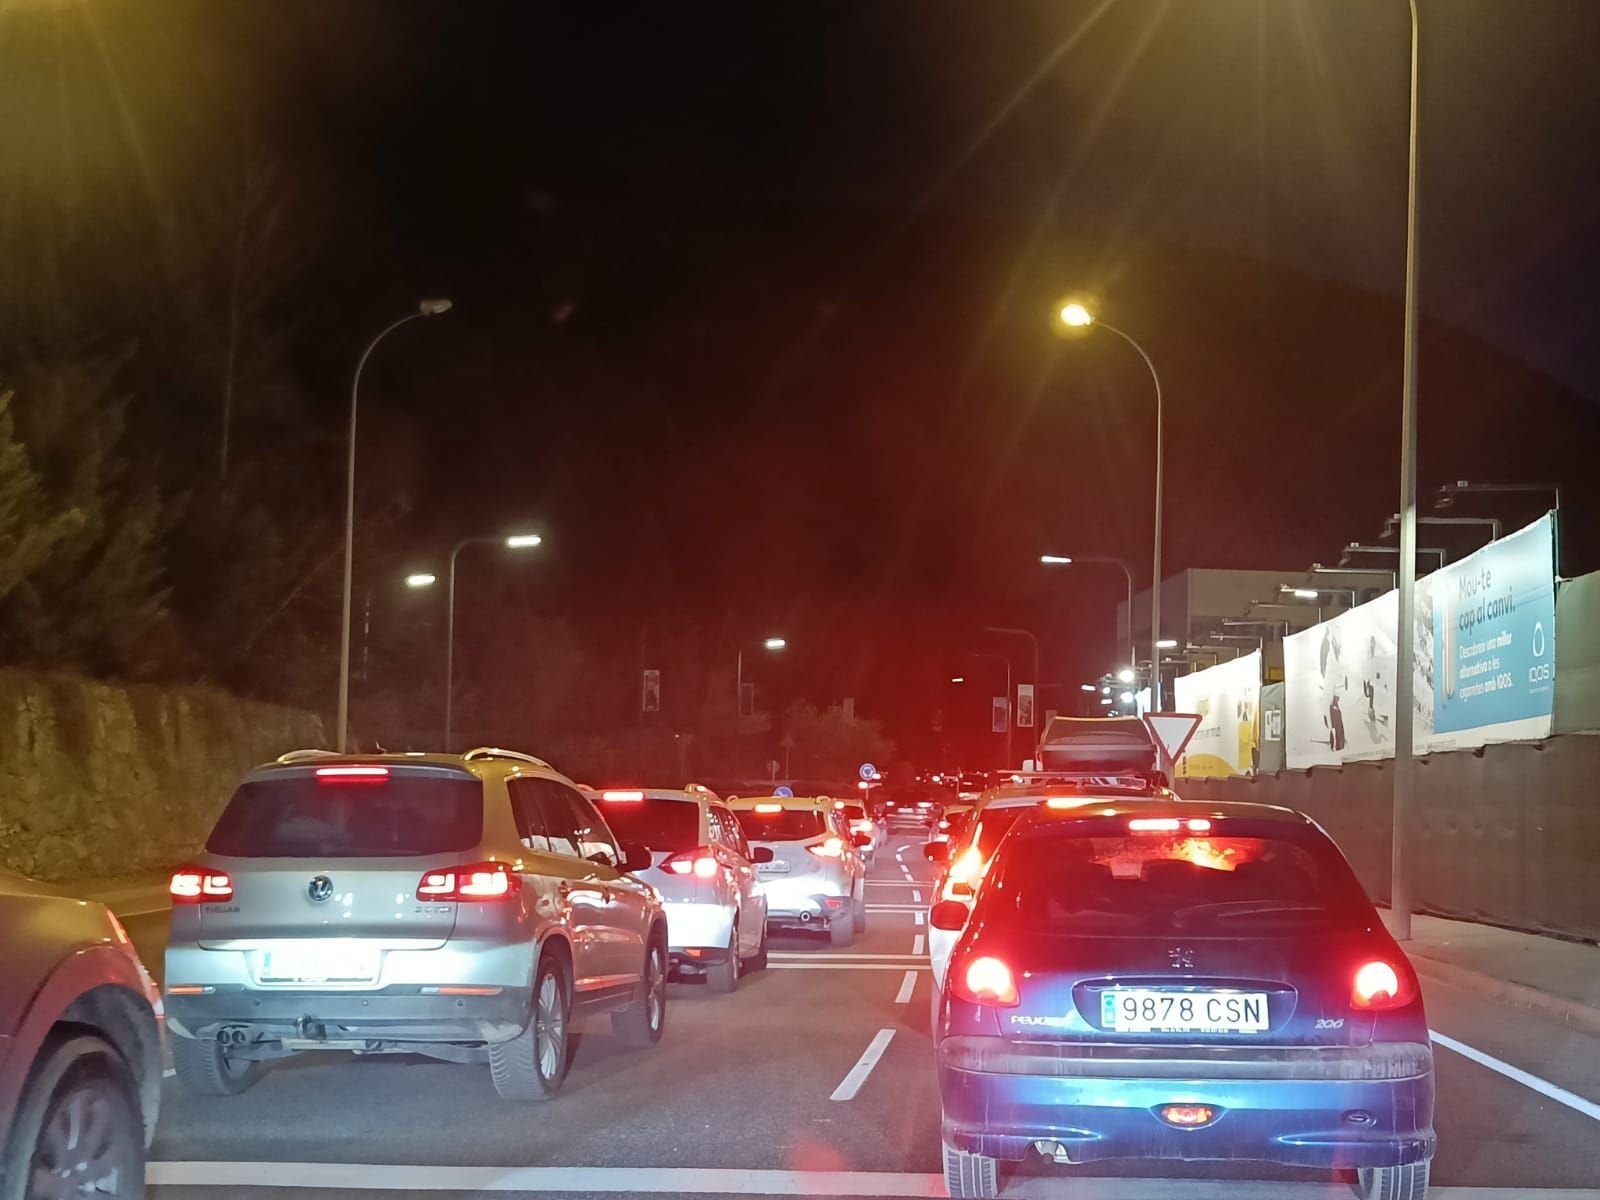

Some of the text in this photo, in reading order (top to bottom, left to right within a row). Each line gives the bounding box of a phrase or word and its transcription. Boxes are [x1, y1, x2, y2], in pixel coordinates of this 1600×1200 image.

[1459, 585, 1516, 636] cap al canvi.
[1123, 996, 1262, 1024] 9878 CSN
[1314, 1018, 1345, 1030] 206
